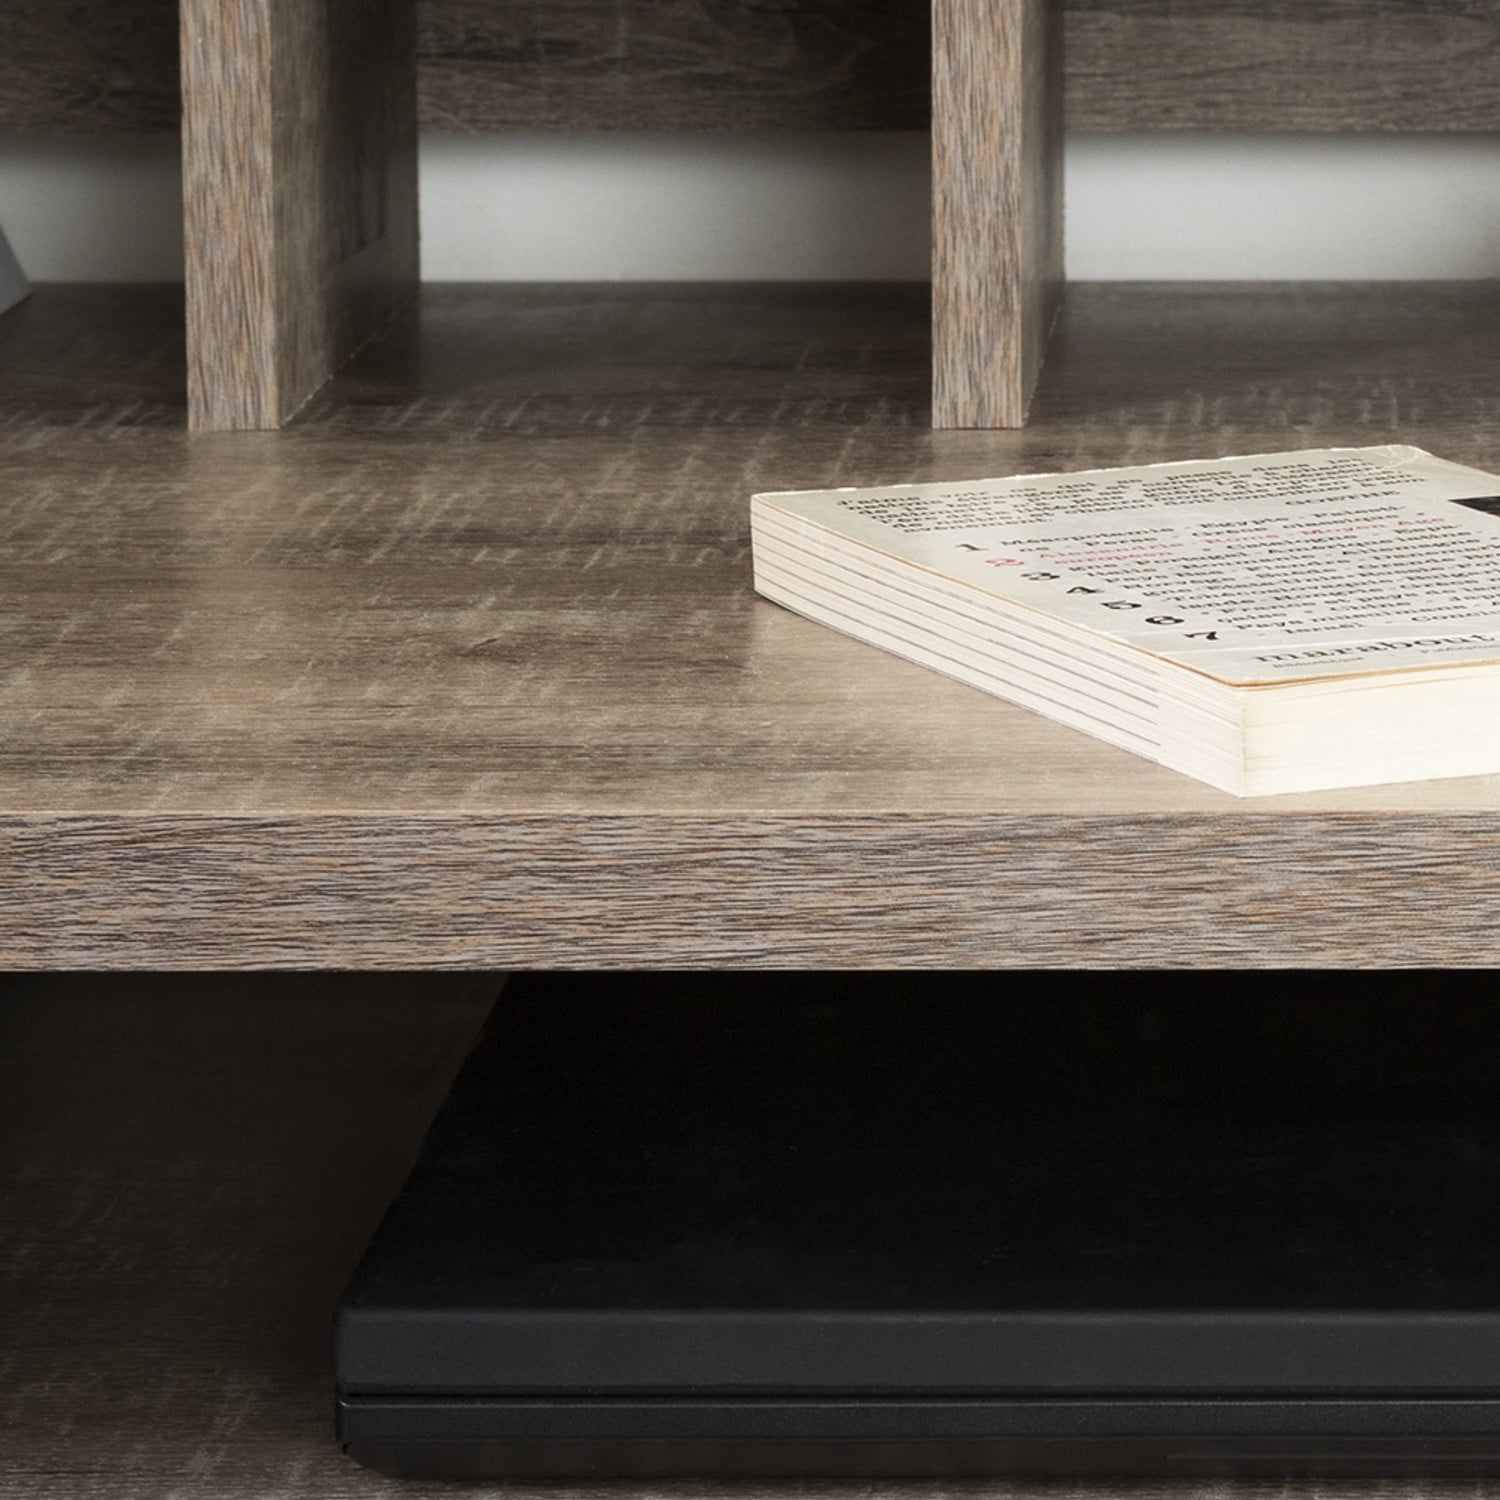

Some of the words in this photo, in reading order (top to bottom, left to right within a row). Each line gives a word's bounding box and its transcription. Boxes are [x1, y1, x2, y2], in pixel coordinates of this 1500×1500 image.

[955, 543, 985, 551] 1
[984, 558, 1024, 567] 2
[1020, 571, 1060, 581] 3
[1065, 585, 1104, 594] 4
[1099, 599, 1142, 610] 5
[1144, 615, 1184, 625] 6
[1182, 630, 1219, 641] 7
[1255, 634, 1493, 661] marabout
